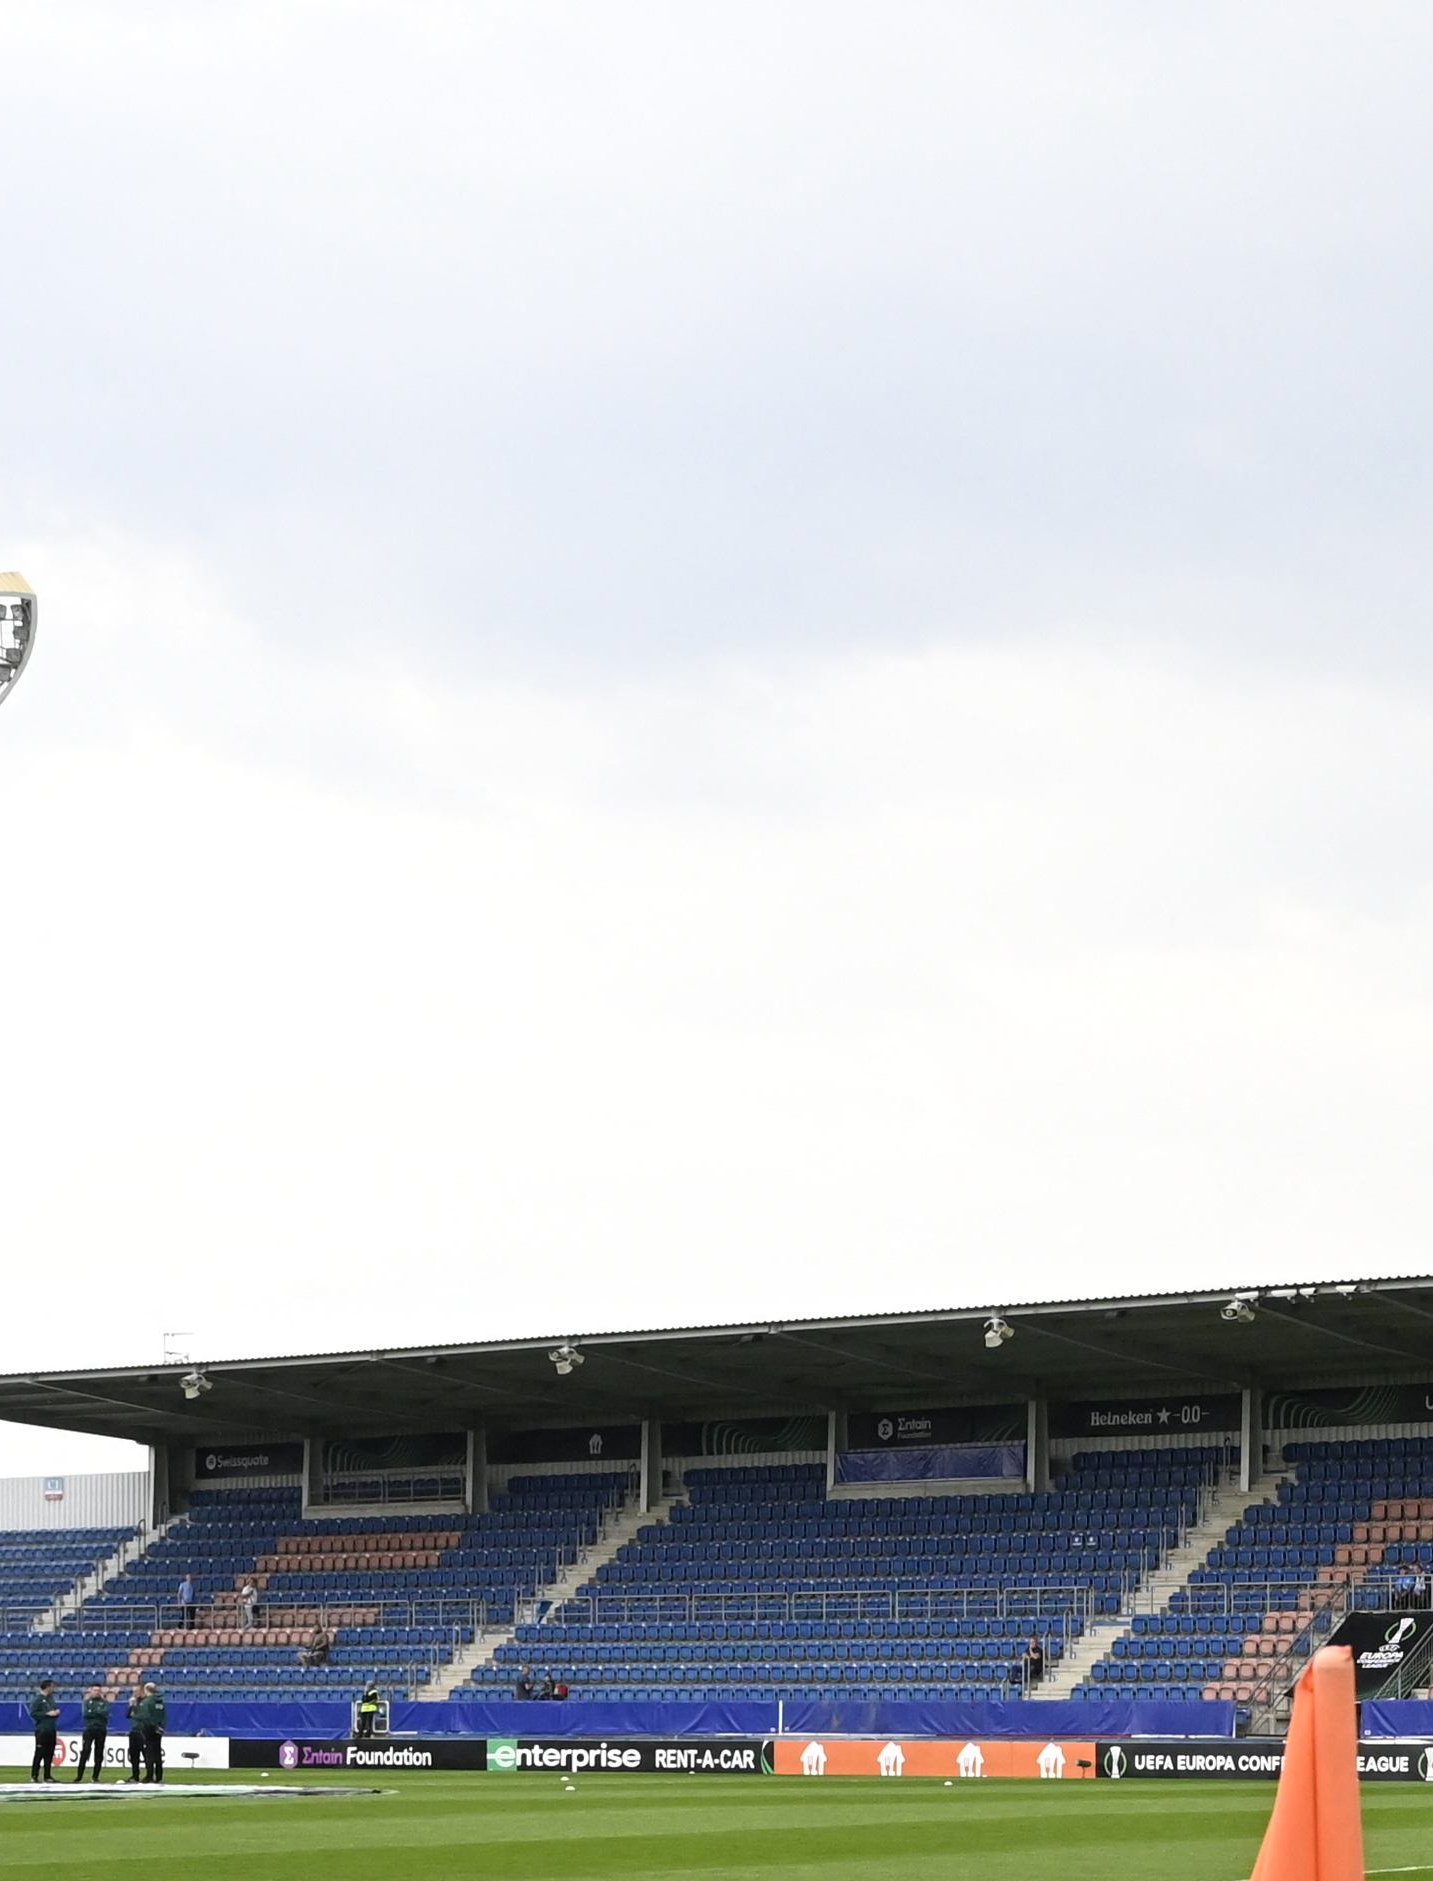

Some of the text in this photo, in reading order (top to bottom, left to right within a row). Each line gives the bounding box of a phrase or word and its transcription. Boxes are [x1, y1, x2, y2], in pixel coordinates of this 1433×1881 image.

[1090, 1406, 1153, 1427] Heineken
[217, 1454, 270, 1470] Swissquote
[345, 1745, 433, 1766] Foundation
[491, 1742, 755, 1772] enterprise RENT-A-CAR
[1133, 1754, 1173, 1772] UEFA
[1175, 1754, 1236, 1772] EUROPA
[1356, 1756, 1410, 1773] EAGUE
